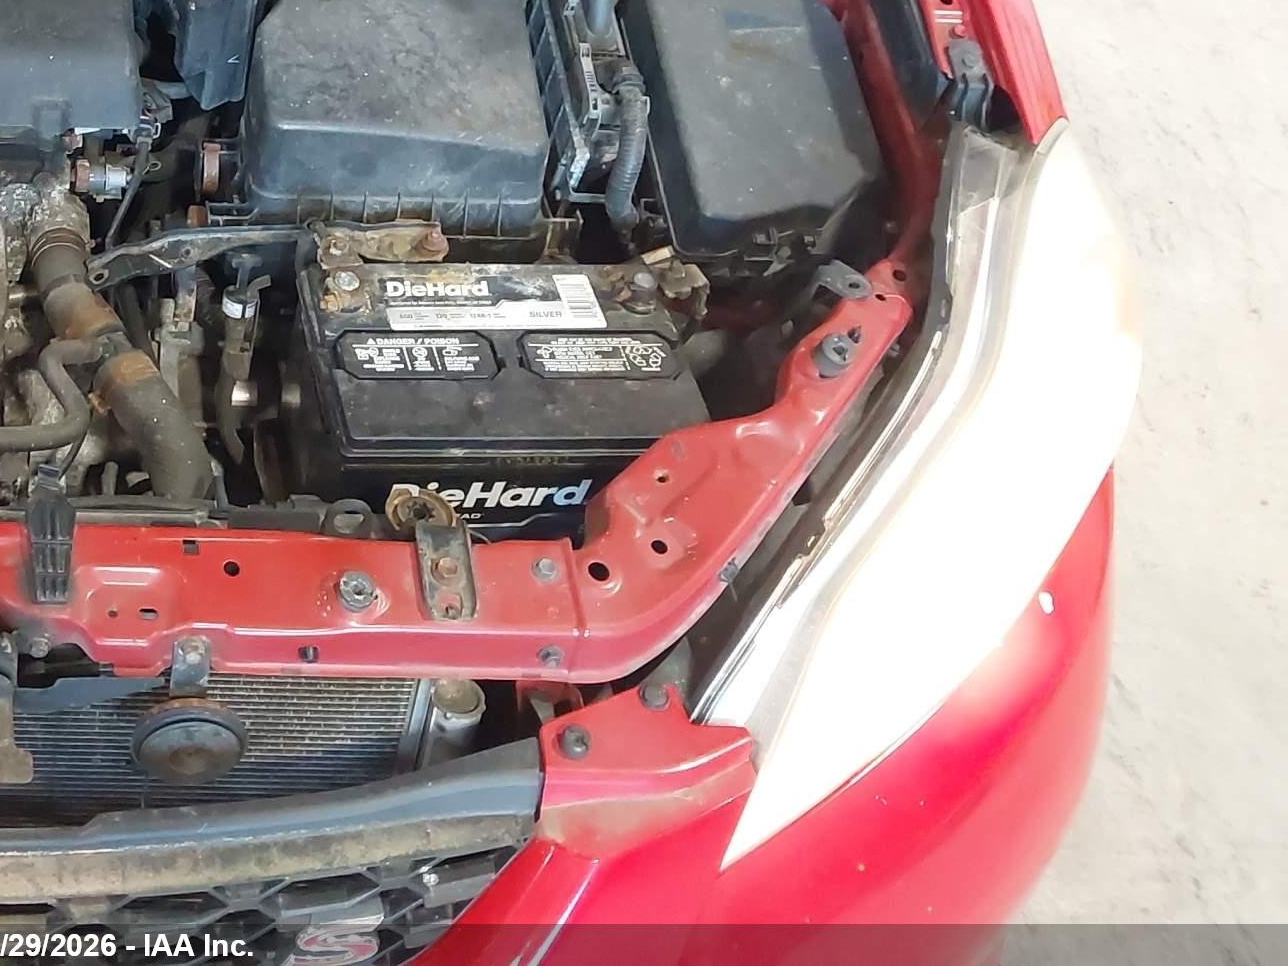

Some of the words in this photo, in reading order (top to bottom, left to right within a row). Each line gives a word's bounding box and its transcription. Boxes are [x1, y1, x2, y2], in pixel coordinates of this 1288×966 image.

[386, 280, 489, 297] DieHard
[529, 310, 563, 318] SILVER
[375, 337, 416, 345] DANGER
[423, 337, 460, 345] POISON
